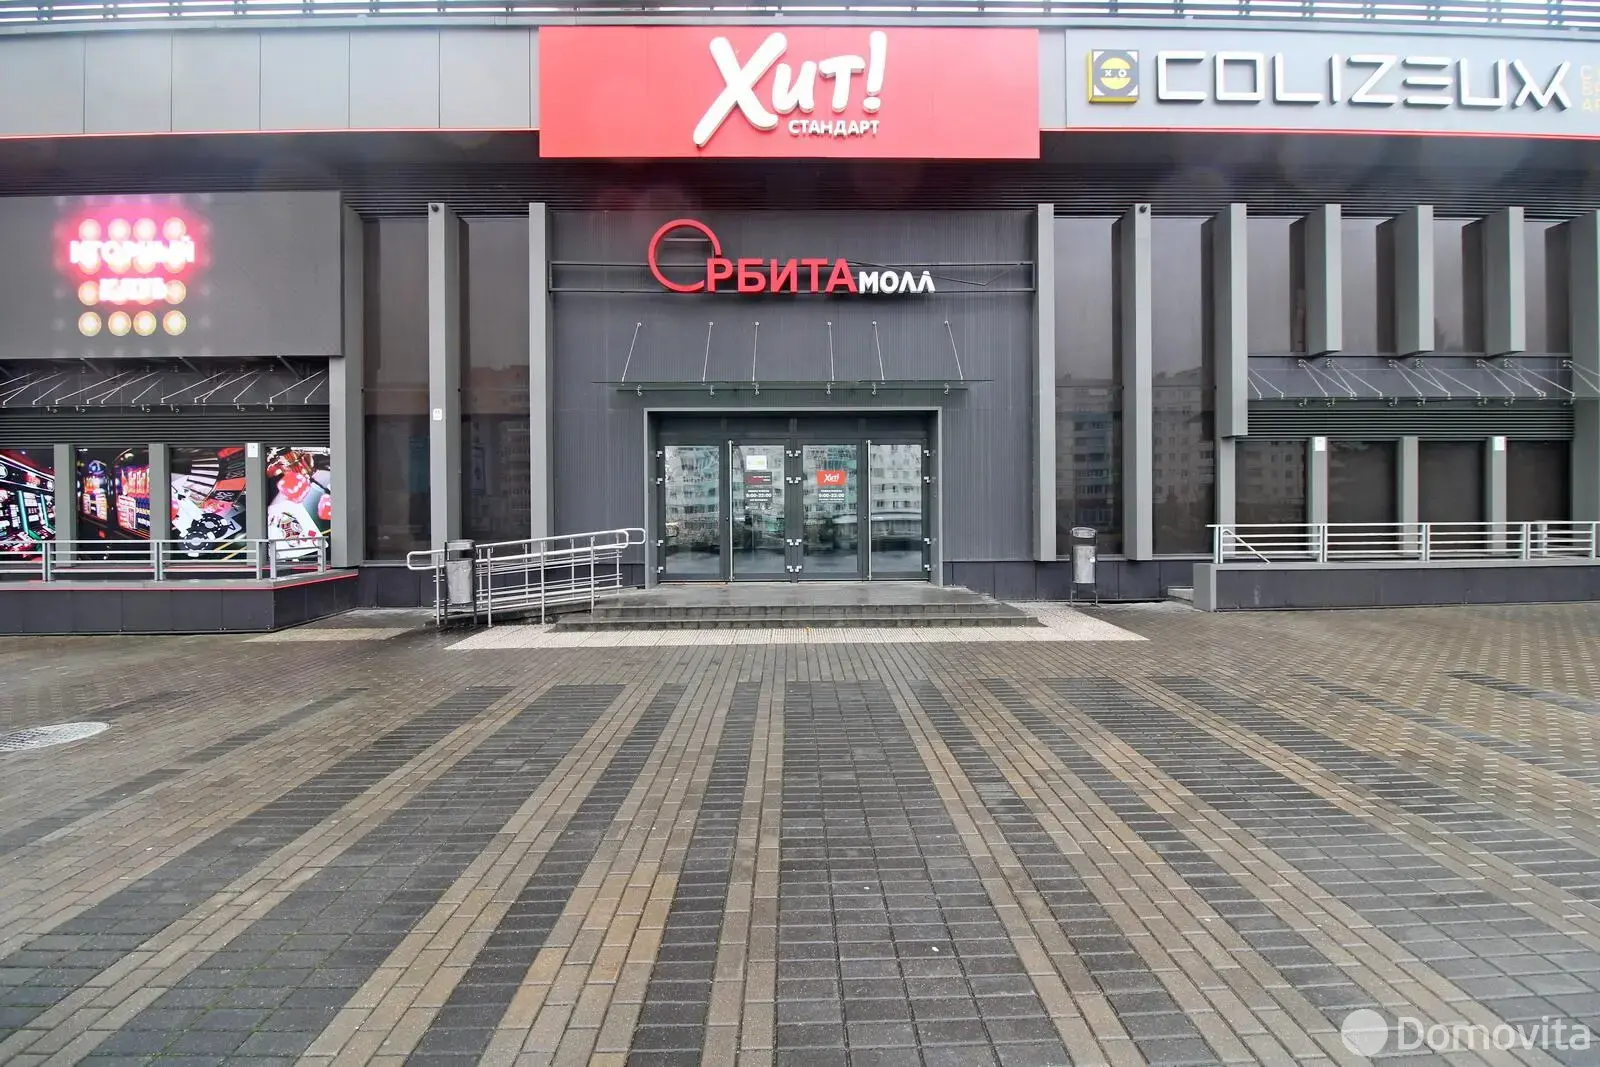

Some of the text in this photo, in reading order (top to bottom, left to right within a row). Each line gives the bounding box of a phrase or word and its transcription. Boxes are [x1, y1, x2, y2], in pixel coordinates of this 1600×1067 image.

[692, 30, 887, 148] Хит!
[788, 119, 881, 138] СТАНДАРТ
[647, 218, 936, 294] ОРБИТА МОЛЛ
